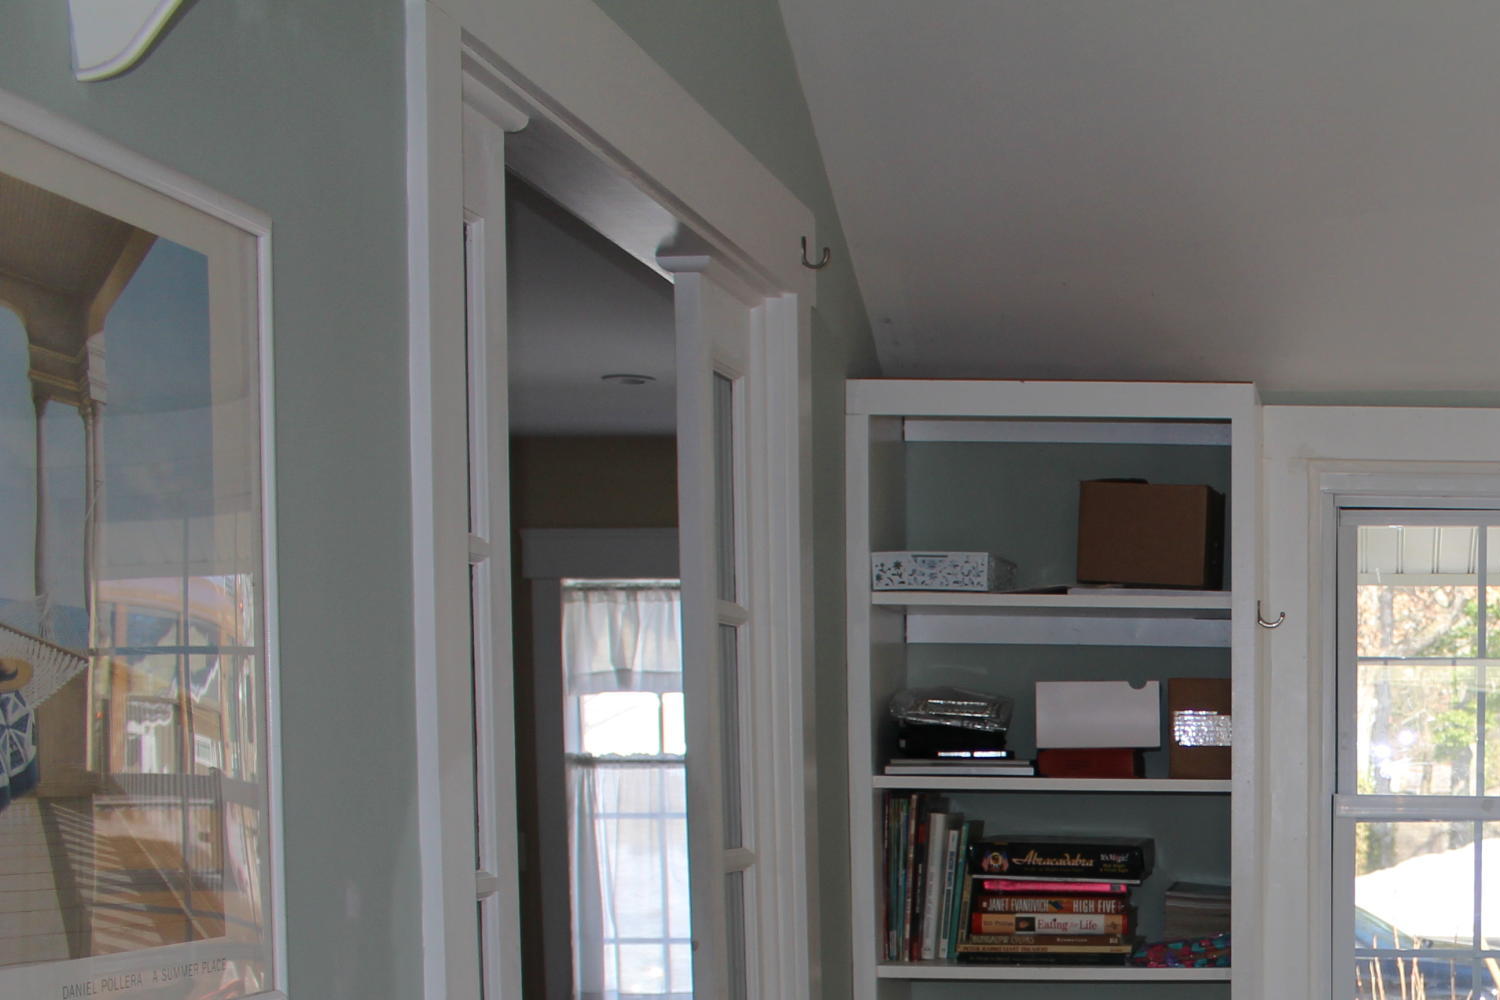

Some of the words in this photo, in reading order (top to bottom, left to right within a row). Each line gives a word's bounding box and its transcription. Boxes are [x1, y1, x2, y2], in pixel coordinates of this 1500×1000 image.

[1012, 850, 1095, 867] Abracadabra
[988, 898, 1009, 912] JANET
[1011, 898, 1049, 912] EVANOVICH
[1072, 899, 1095, 913] HIGH
[1097, 899, 1117, 913] FIVE
[1037, 918, 1069, 932] Eating
[1079, 919, 1098, 930] Life
[62, 980, 97, 1000] DANIEL
[101, 973, 143, 993] POLLERA
[152, 970, 159, 984] A
[161, 963, 200, 982] SUMMER
[201, 957, 227, 976] PLACE
